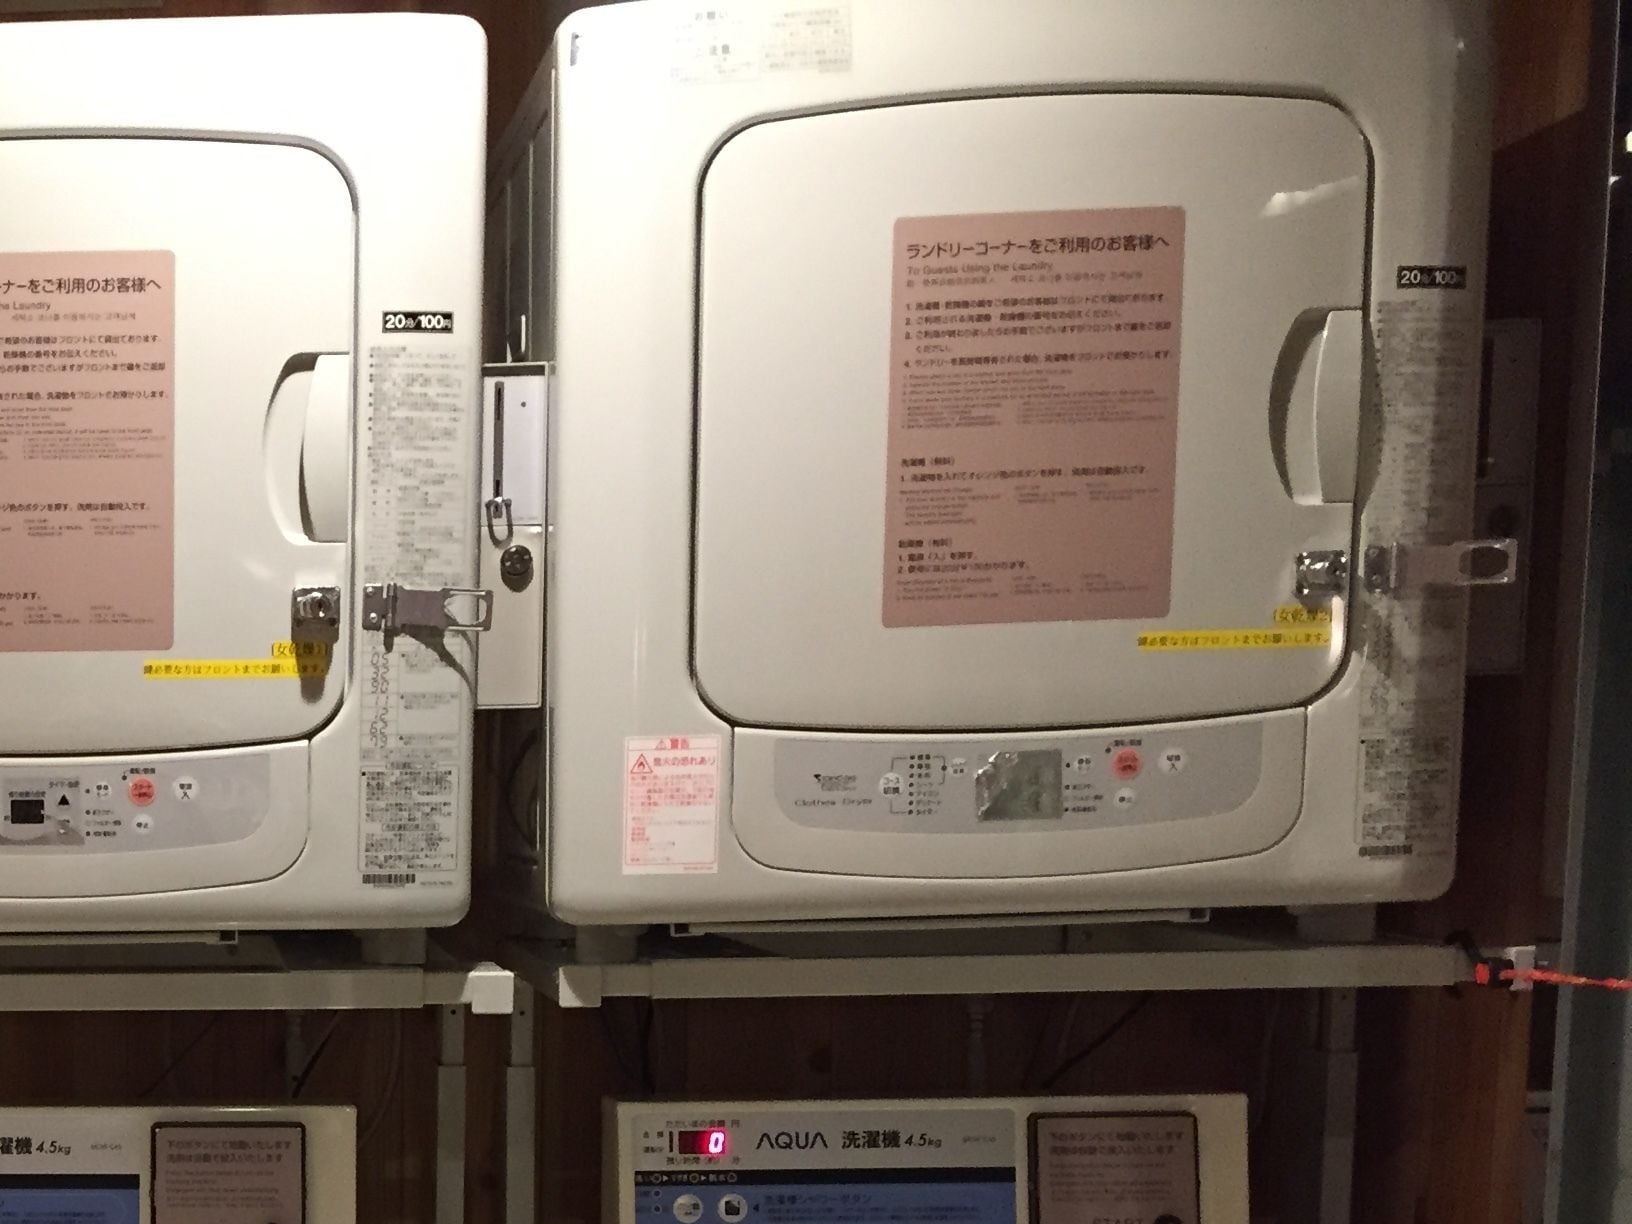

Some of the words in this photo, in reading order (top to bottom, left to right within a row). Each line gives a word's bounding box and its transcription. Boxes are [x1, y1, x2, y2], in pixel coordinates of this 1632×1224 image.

[906, 235, 1170, 259] ランドリーコーナーをご利用のお客様へ
[385, 314, 452, 329] 20分/100円
[35, 1140, 72, 1156] 4.5kg
[708, 1131, 725, 1154] 0
[841, 1130, 901, 1149] 洗濯機
[904, 1133, 943, 1149] 4.5kg
